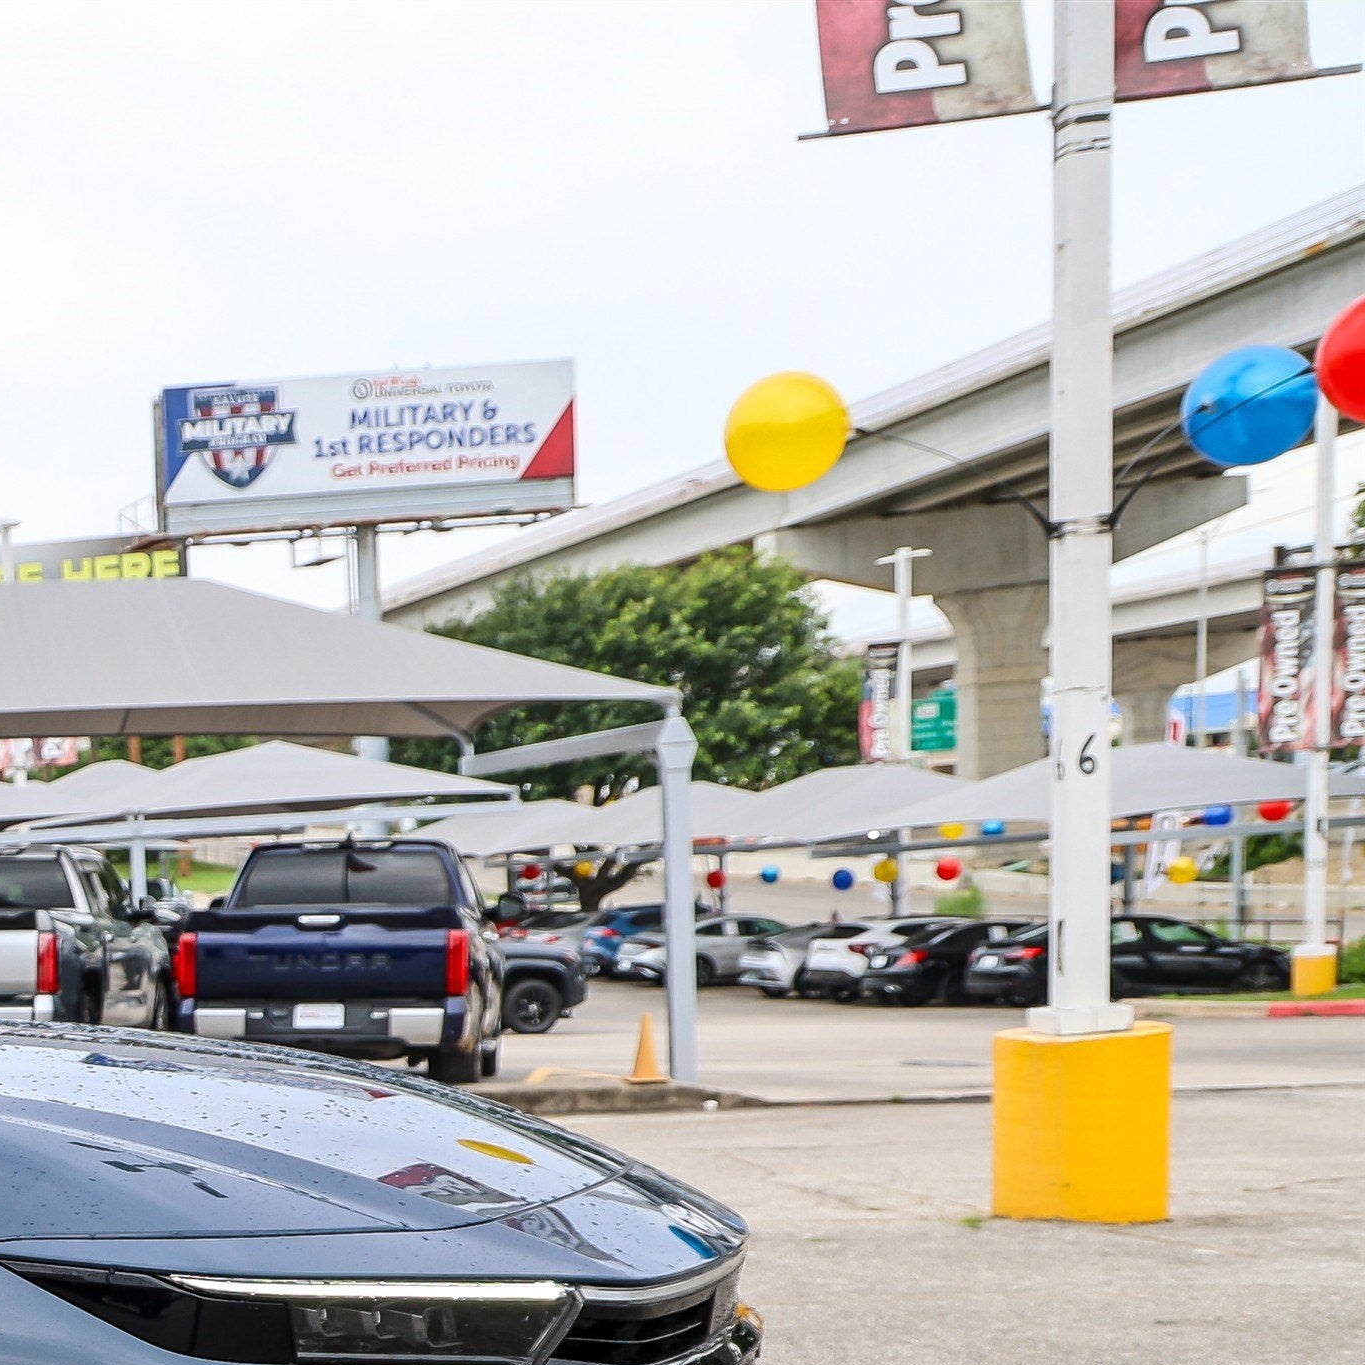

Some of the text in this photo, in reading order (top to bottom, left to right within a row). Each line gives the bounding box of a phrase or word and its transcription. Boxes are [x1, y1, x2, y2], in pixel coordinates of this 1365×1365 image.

[873, 0, 967, 94] Pr
[1144, 0, 1240, 64] P
[181, 412, 294, 441] MILITARY
[350, 398, 499, 429] MILITARY &
[314, 421, 538, 459] 1st RESPONDERS
[331, 453, 520, 479] Get Preferred Pricing
[1270, 608, 1301, 698] Owned
[1269, 699, 1300, 743] Pre
[1079, 734, 1095, 775] 6
[248, 953, 391, 972] TUNDRA
